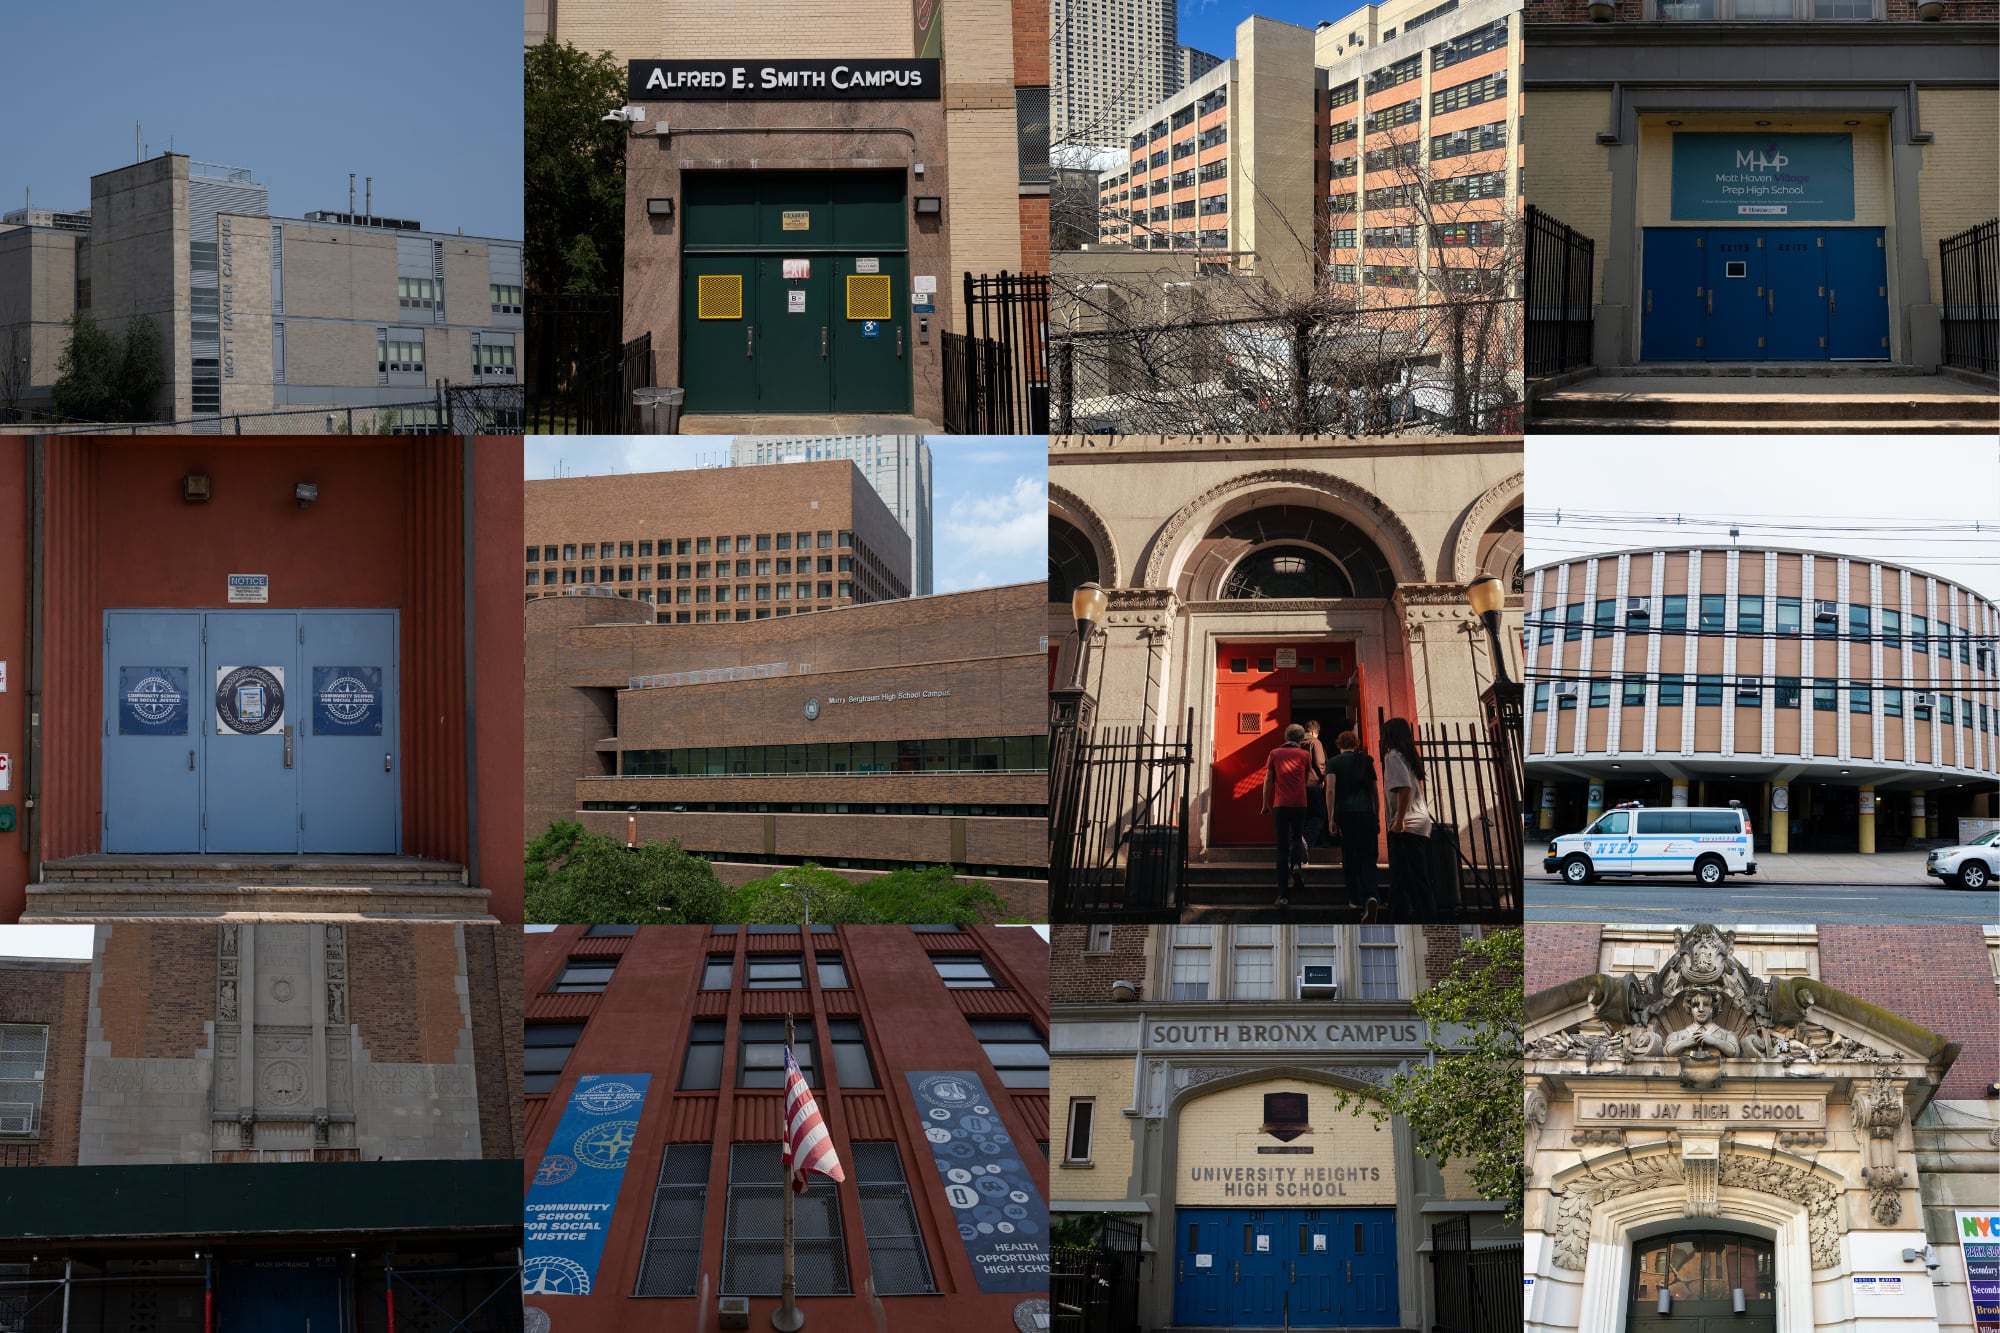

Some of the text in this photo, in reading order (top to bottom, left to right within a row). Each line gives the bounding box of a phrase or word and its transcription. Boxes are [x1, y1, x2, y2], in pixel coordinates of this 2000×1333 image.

[732, 67, 755, 90] E.
[1715, 173, 1810, 185] Mott Haven Village
[1722, 185, 1804, 196] Prep High School
[222, 217, 234, 379] MOTT HAVEN CAMPUS
[231, 577, 265, 585] NOTICE
[882, 693, 897, 702] High
[898, 691, 921, 700] School
[922, 689, 952, 698] Campus
[1596, 842, 1639, 855] NYPD
[1153, 1024, 1418, 1043] SOUTH BRONX CAMPUS
[361, 1080, 403, 1094] HIGH
[1596, 1103, 1805, 1120] JOHN JAY HIGH SCHOOL
[1191, 1167, 1381, 1182] UNIVERSITY HEIGHTS
[1225, 1182, 1347, 1197] HIGH SCHOOL
[526, 1203, 610, 1212] COMMUNITY
[536, 1212, 591, 1221] SCHOOL
[1250, 1209, 1265, 1222] EXIT
[1304, 1209, 1321, 1222] EXIT
[550, 1222, 602, 1231] SOCIAL
[1962, 1216, 2000, 1237] NYC
[527, 1232, 588, 1241] JUSTICE
[994, 1243, 1039, 1252] HEALTH
[1965, 1246, 1987, 1258] PARK
[983, 1265, 1016, 1274] HIGH
[1968, 1265, 1998, 1277] Secondary
